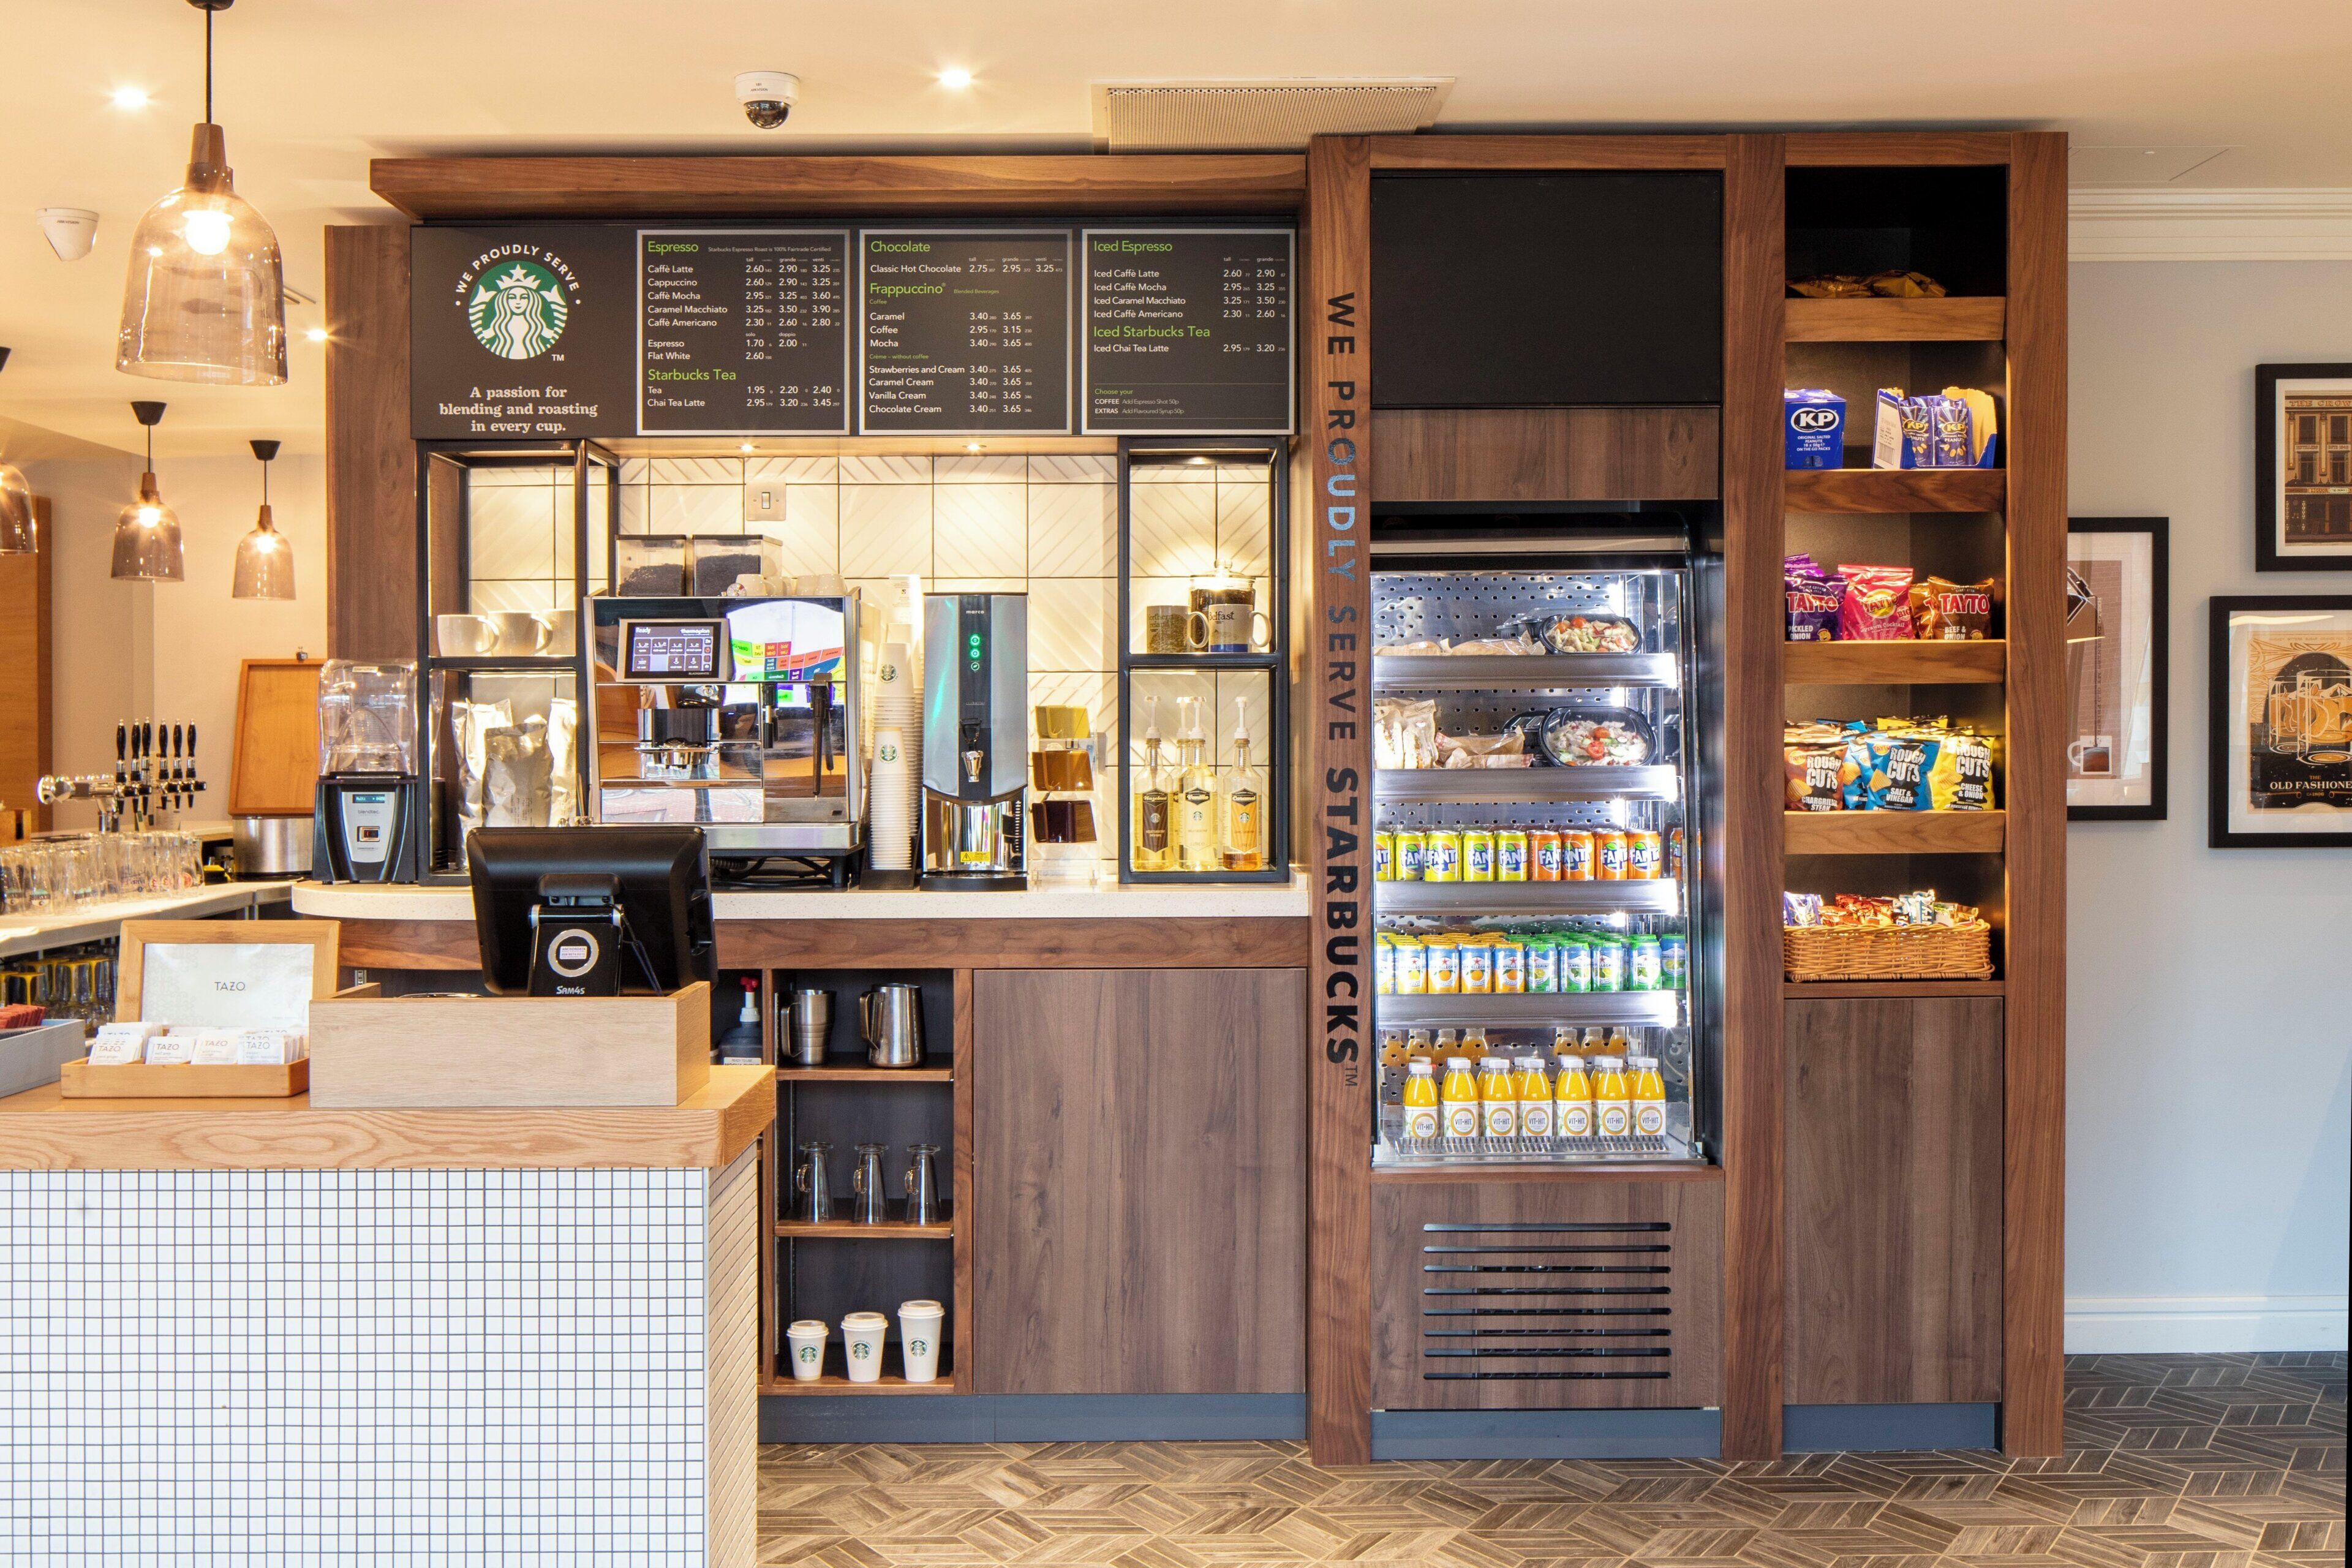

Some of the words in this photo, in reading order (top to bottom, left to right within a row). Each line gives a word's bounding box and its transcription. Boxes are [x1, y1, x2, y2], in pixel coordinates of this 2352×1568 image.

[649, 241, 698, 255] Espresso
[871, 241, 930, 252] Chocolate
[1095, 241, 1118, 251] Iced
[1122, 241, 1172, 255] Espresso
[456, 271, 473, 293] WE
[472, 244, 540, 271] PROUDLY
[544, 252, 579, 291] SERVE
[648, 279, 697, 287] Cappuccino
[1327, 292, 1355, 355] WE
[1095, 326, 1119, 337] Iced
[1124, 326, 1183, 337] Starbucks
[1188, 326, 1210, 336] Tea
[648, 339, 684, 349] Espresso
[649, 369, 709, 380] Starbucks
[713, 369, 736, 380] Tea
[470, 387, 481, 397] A
[487, 386, 540, 400] passion
[546, 386, 567, 397] for
[439, 404, 502, 417] blending
[507, 403, 533, 414] and
[538, 403, 598, 417] roasting
[1800, 412, 1834, 426] KP
[472, 420, 486, 431] in
[491, 423, 531, 433] every
[537, 423, 566, 434] cup.
[1327, 381, 1355, 581] PROUDLY
[1786, 592, 1839, 613] TAYTO
[1939, 593, 1989, 614] TAYTO
[1210, 611, 1234, 620] Belfast
[1898, 608, 1910, 617] BIG
[1328, 605, 1355, 740] SERVE
[2097, 673, 2102, 684] MY
[1890, 747, 1926, 764] ROUGH
[1807, 756, 1842, 772] ROUGH
[1887, 760, 1920, 782] CUTS
[1955, 756, 1991, 778] CUTS
[1806, 768, 1838, 790] CUTS
[1961, 783, 1983, 792] CHEESE
[1887, 794, 1913, 804] VINEGAR
[1325, 767, 1359, 1063] STARBUCKS
[214, 981, 245, 991] TAZO
